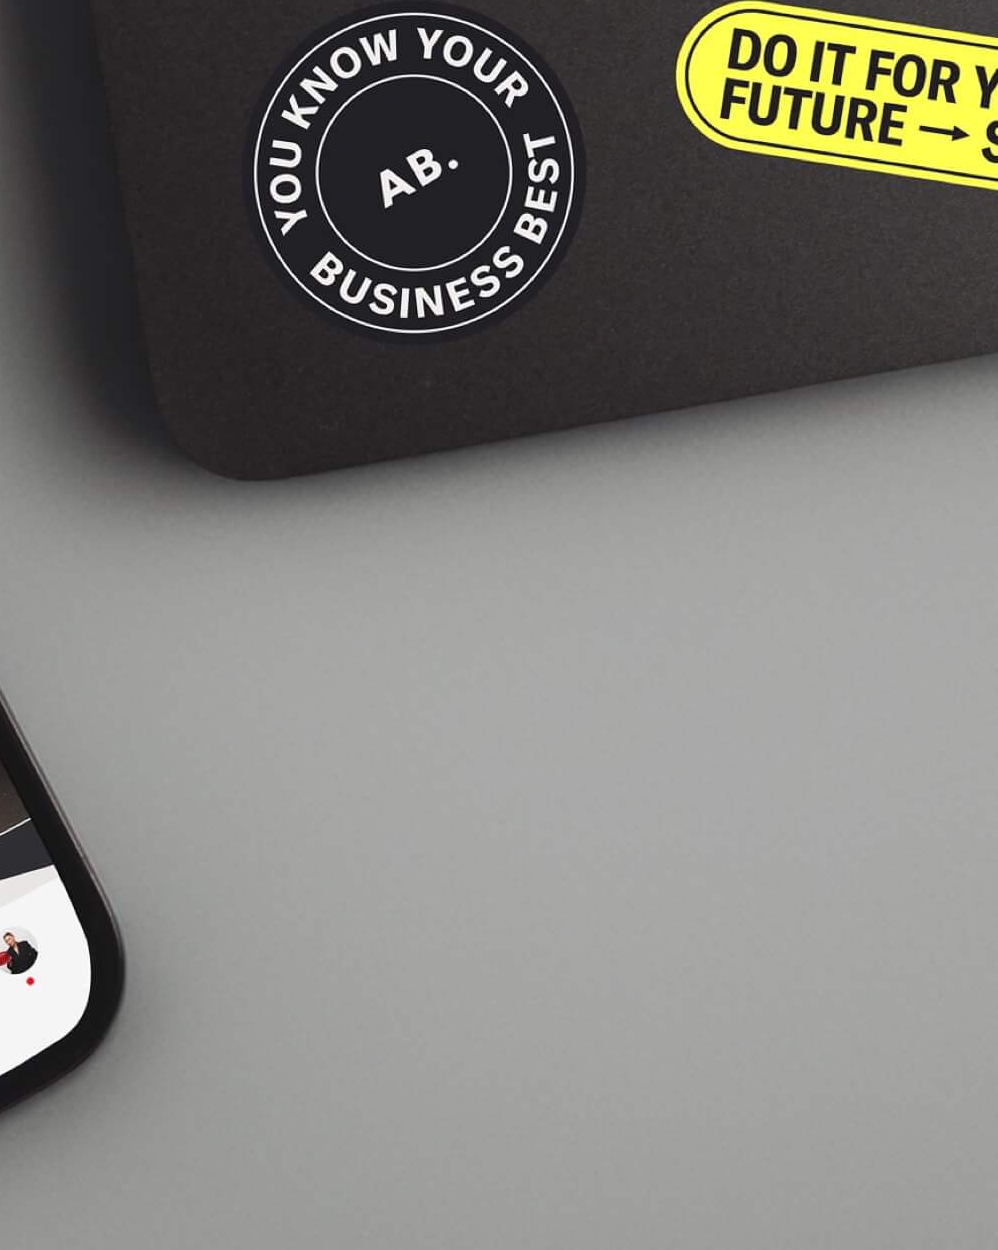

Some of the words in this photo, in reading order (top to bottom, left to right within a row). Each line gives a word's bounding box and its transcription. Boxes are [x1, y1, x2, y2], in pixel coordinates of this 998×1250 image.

[281, 29, 397, 130] KNOW
[416, 27, 529, 108] YOUR
[727, 28, 797, 78] DO
[810, 41, 856, 86] IT
[865, 49, 960, 104] FOR
[720, 77, 907, 147] FUTURE
[269, 139, 307, 236] YOU
[378, 148, 459, 209] AB.
[309, 245, 524, 319] BUSINESS
[513, 133, 560, 245] BEST
